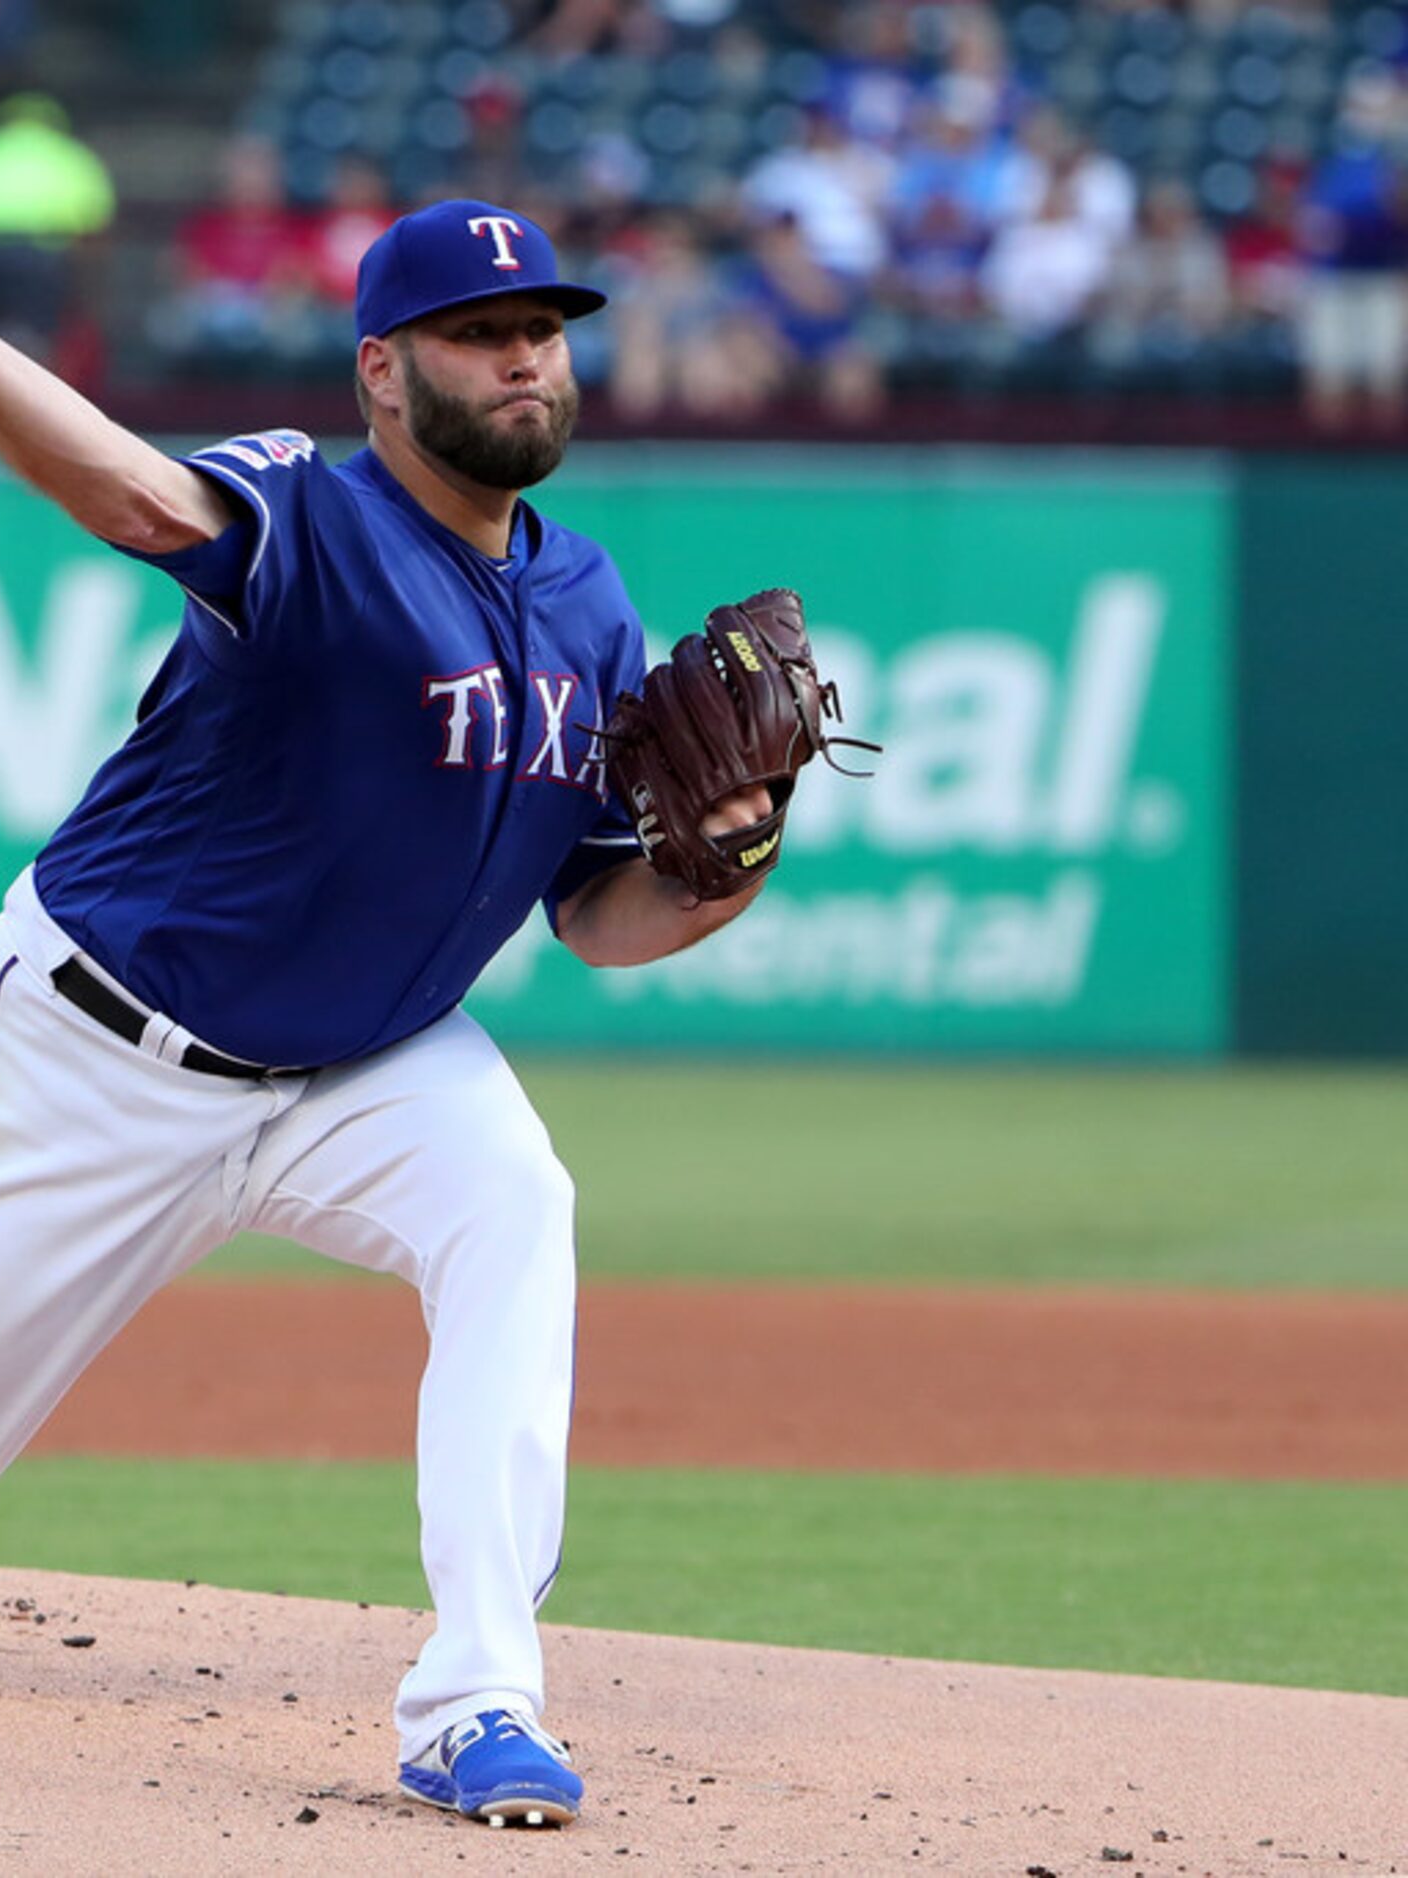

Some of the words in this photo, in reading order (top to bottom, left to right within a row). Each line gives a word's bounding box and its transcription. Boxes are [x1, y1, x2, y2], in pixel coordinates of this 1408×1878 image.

[467, 216, 523, 271] T
[421, 661, 609, 803] TEXA
[600, 872, 1104, 1005] ental
